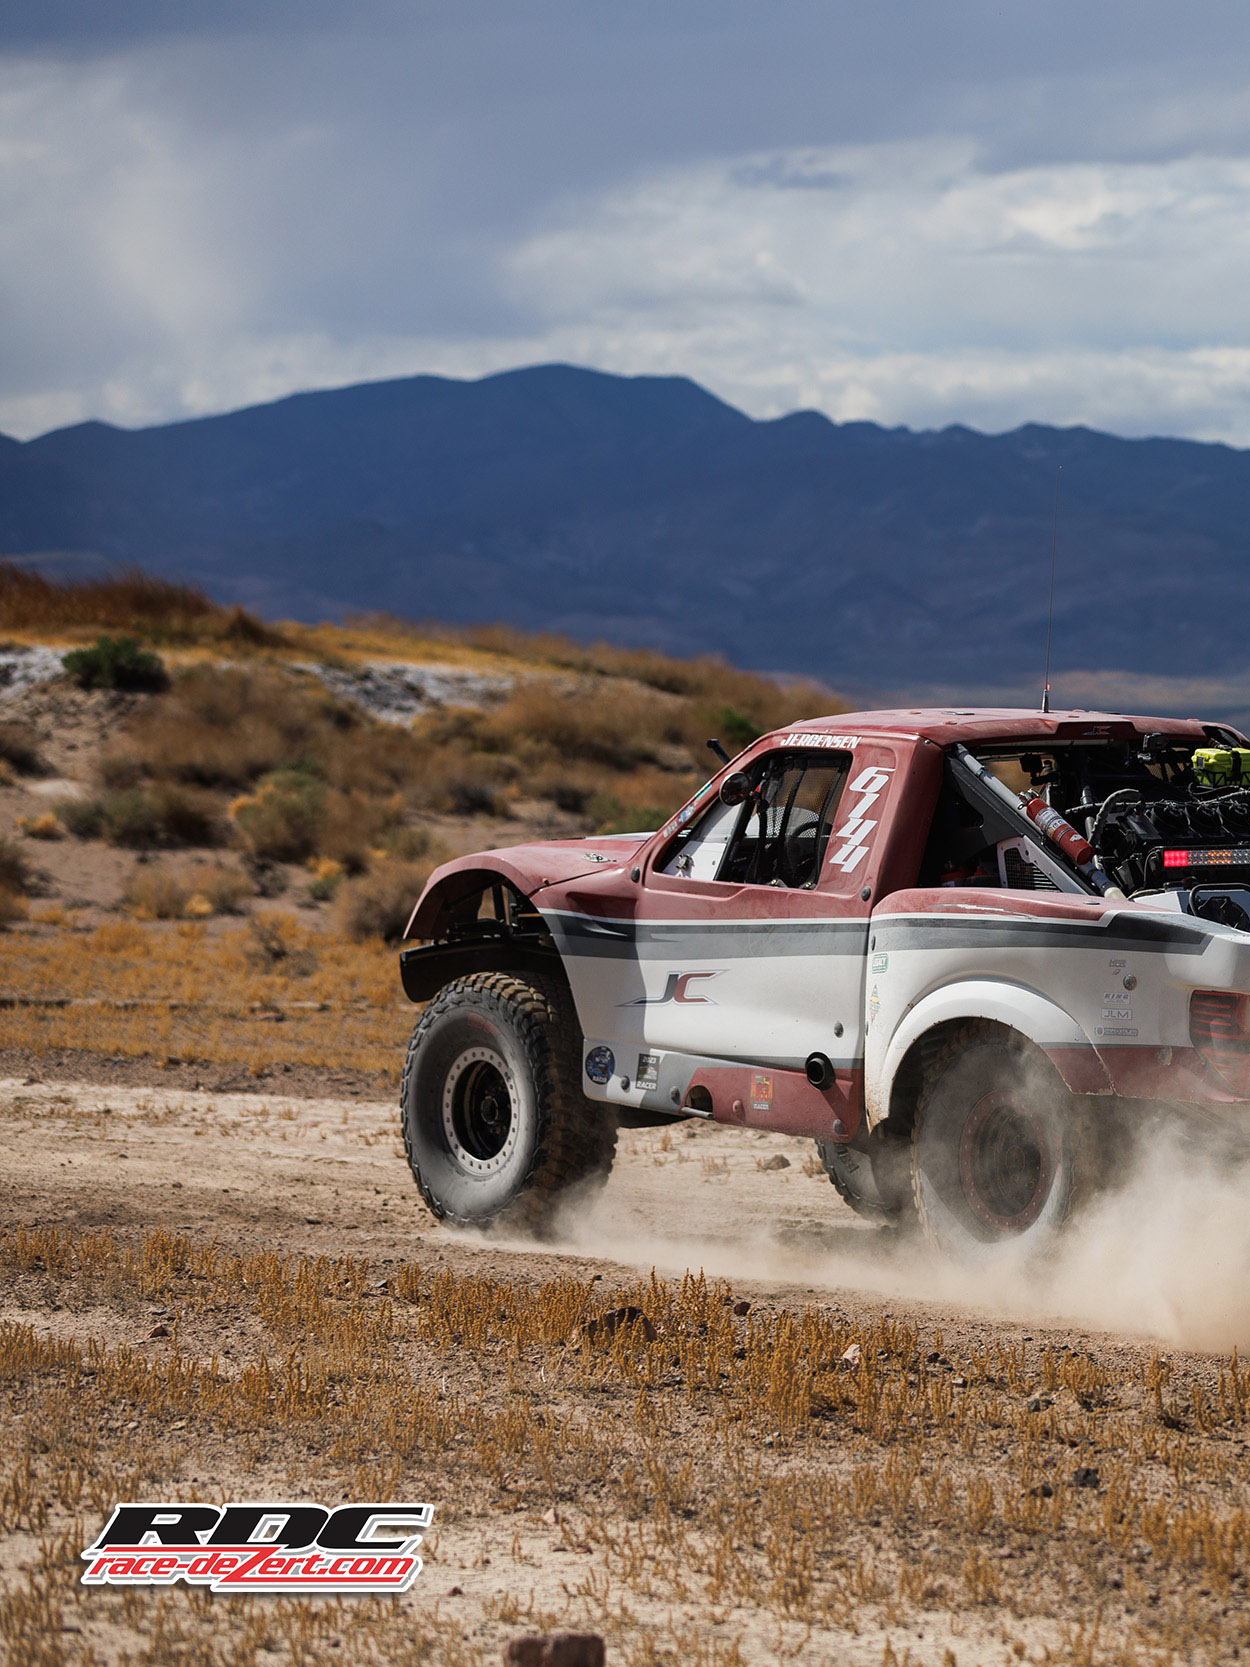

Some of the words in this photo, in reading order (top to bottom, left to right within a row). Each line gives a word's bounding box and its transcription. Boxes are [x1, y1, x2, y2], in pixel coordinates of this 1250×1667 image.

[780, 733, 862, 749] JERGENSEN
[829, 766, 896, 873] 6144
[614, 968, 730, 1008] JC
[1104, 1010, 1129, 1019] JLM
[636, 1080, 657, 1090] RACER
